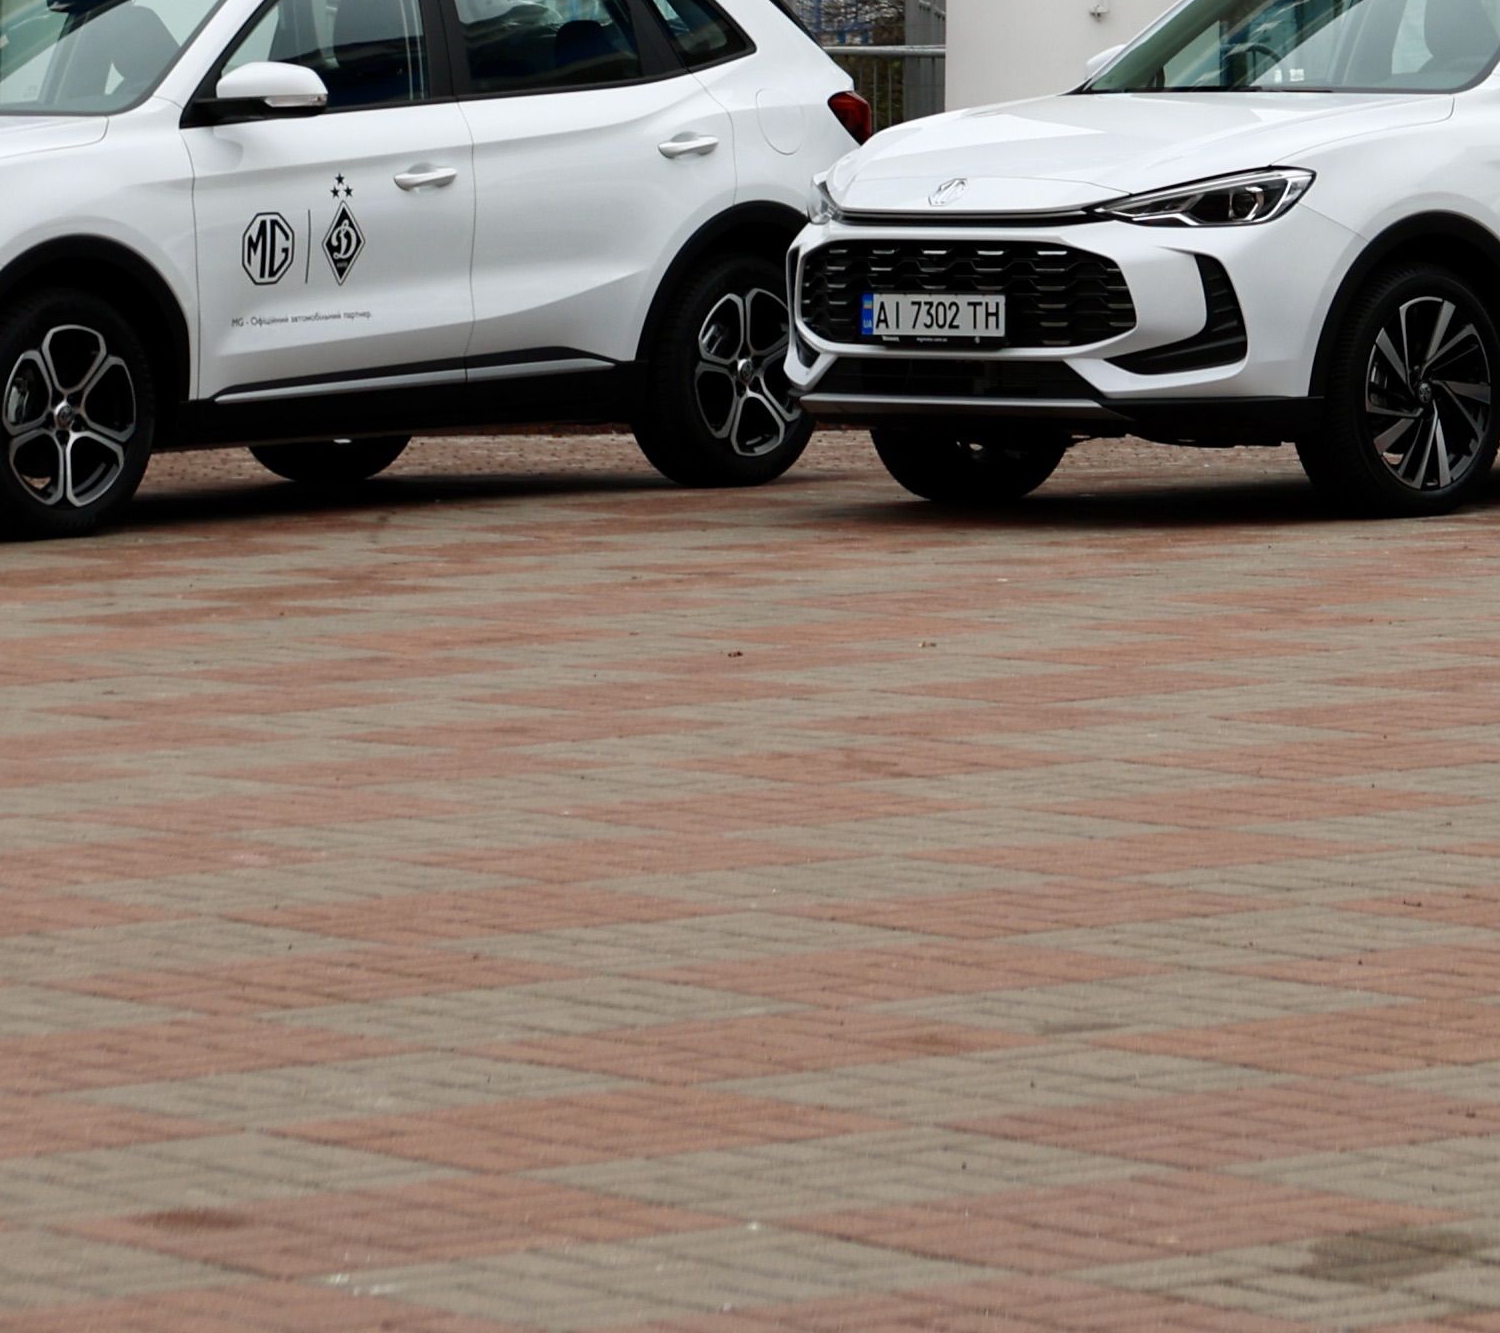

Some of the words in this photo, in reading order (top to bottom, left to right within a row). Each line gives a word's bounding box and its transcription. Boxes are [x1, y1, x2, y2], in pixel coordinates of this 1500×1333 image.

[247, 219, 290, 279] MG
[231, 317, 244, 327] MG
[875, 301, 900, 330] AI
[911, 301, 960, 330] 7302
[967, 301, 1000, 330] TH
